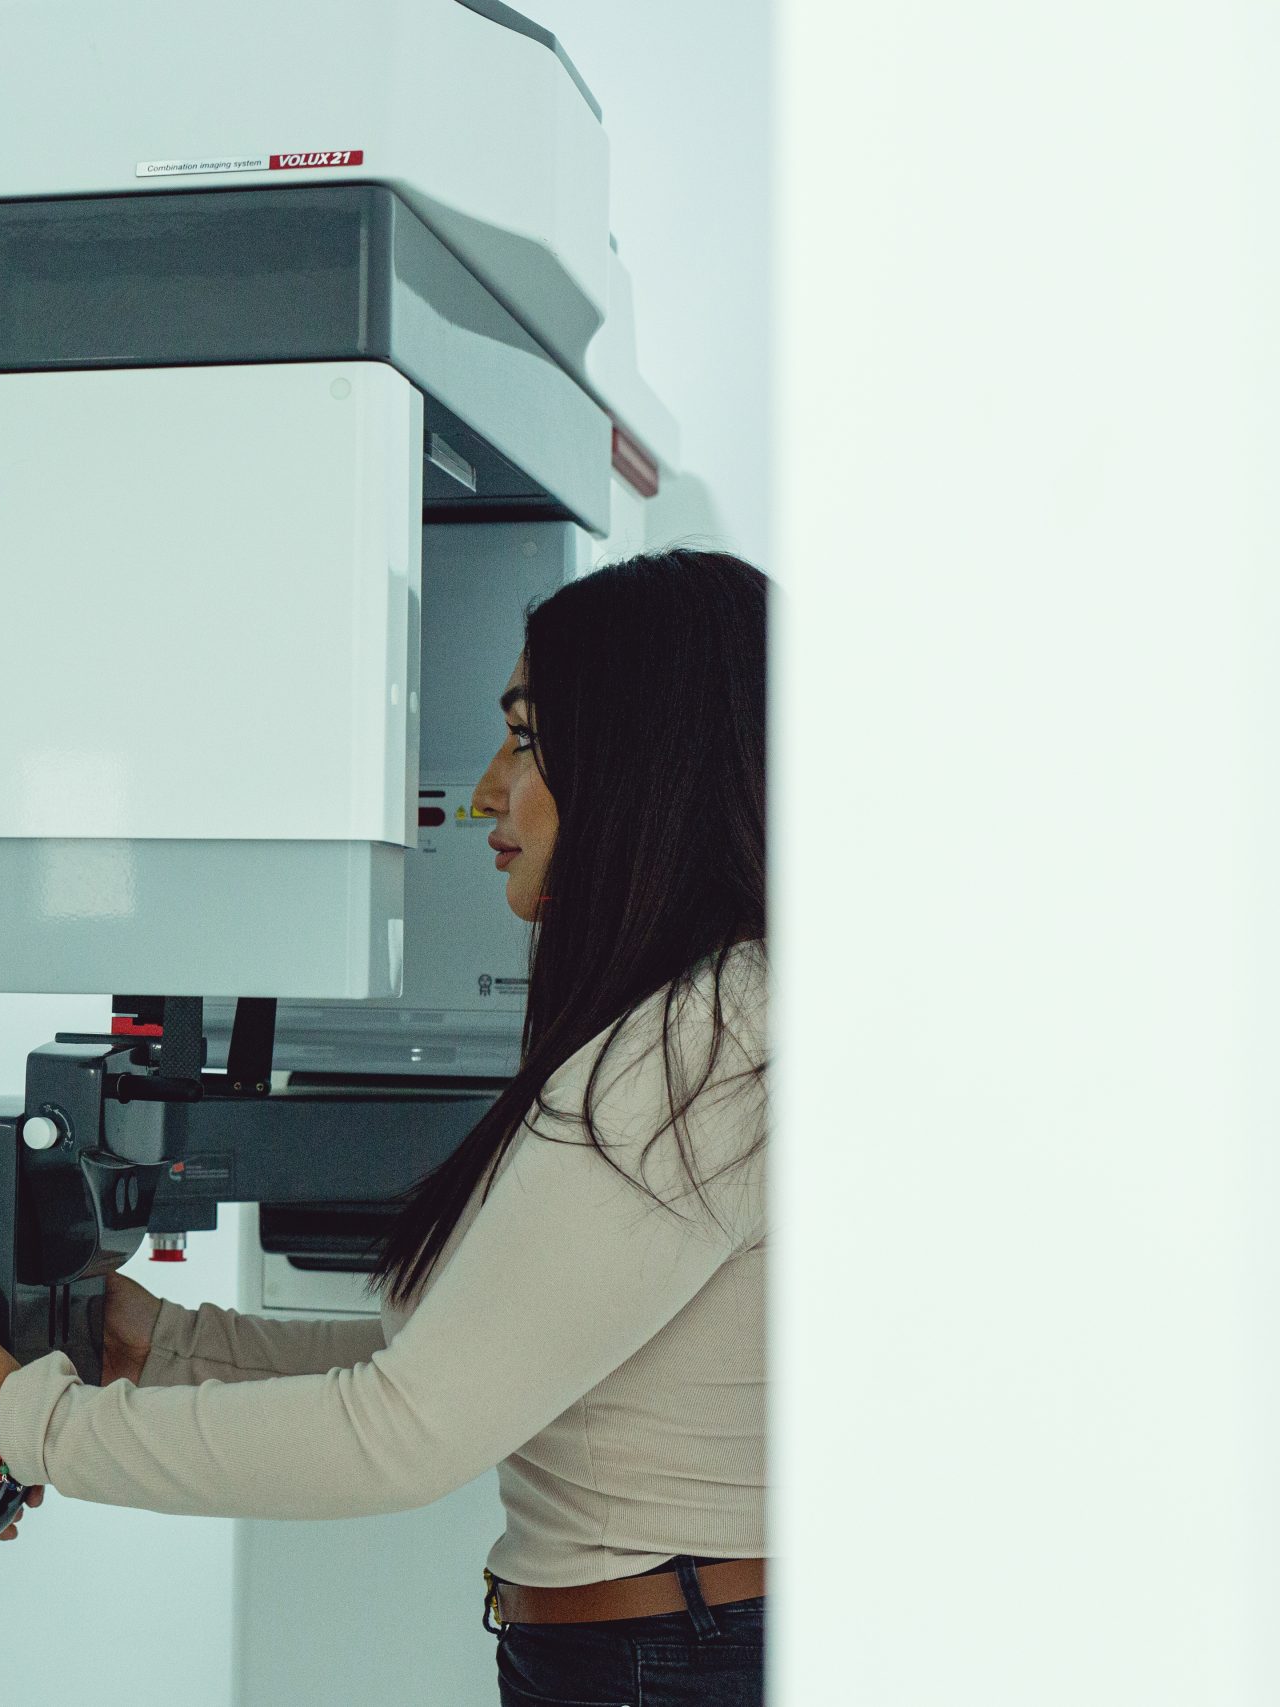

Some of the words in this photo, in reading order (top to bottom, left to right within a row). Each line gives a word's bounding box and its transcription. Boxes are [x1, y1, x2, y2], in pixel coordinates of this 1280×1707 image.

[147, 162, 198, 172] Combination
[200, 161, 231, 171] imaging
[233, 159, 262, 169] system
